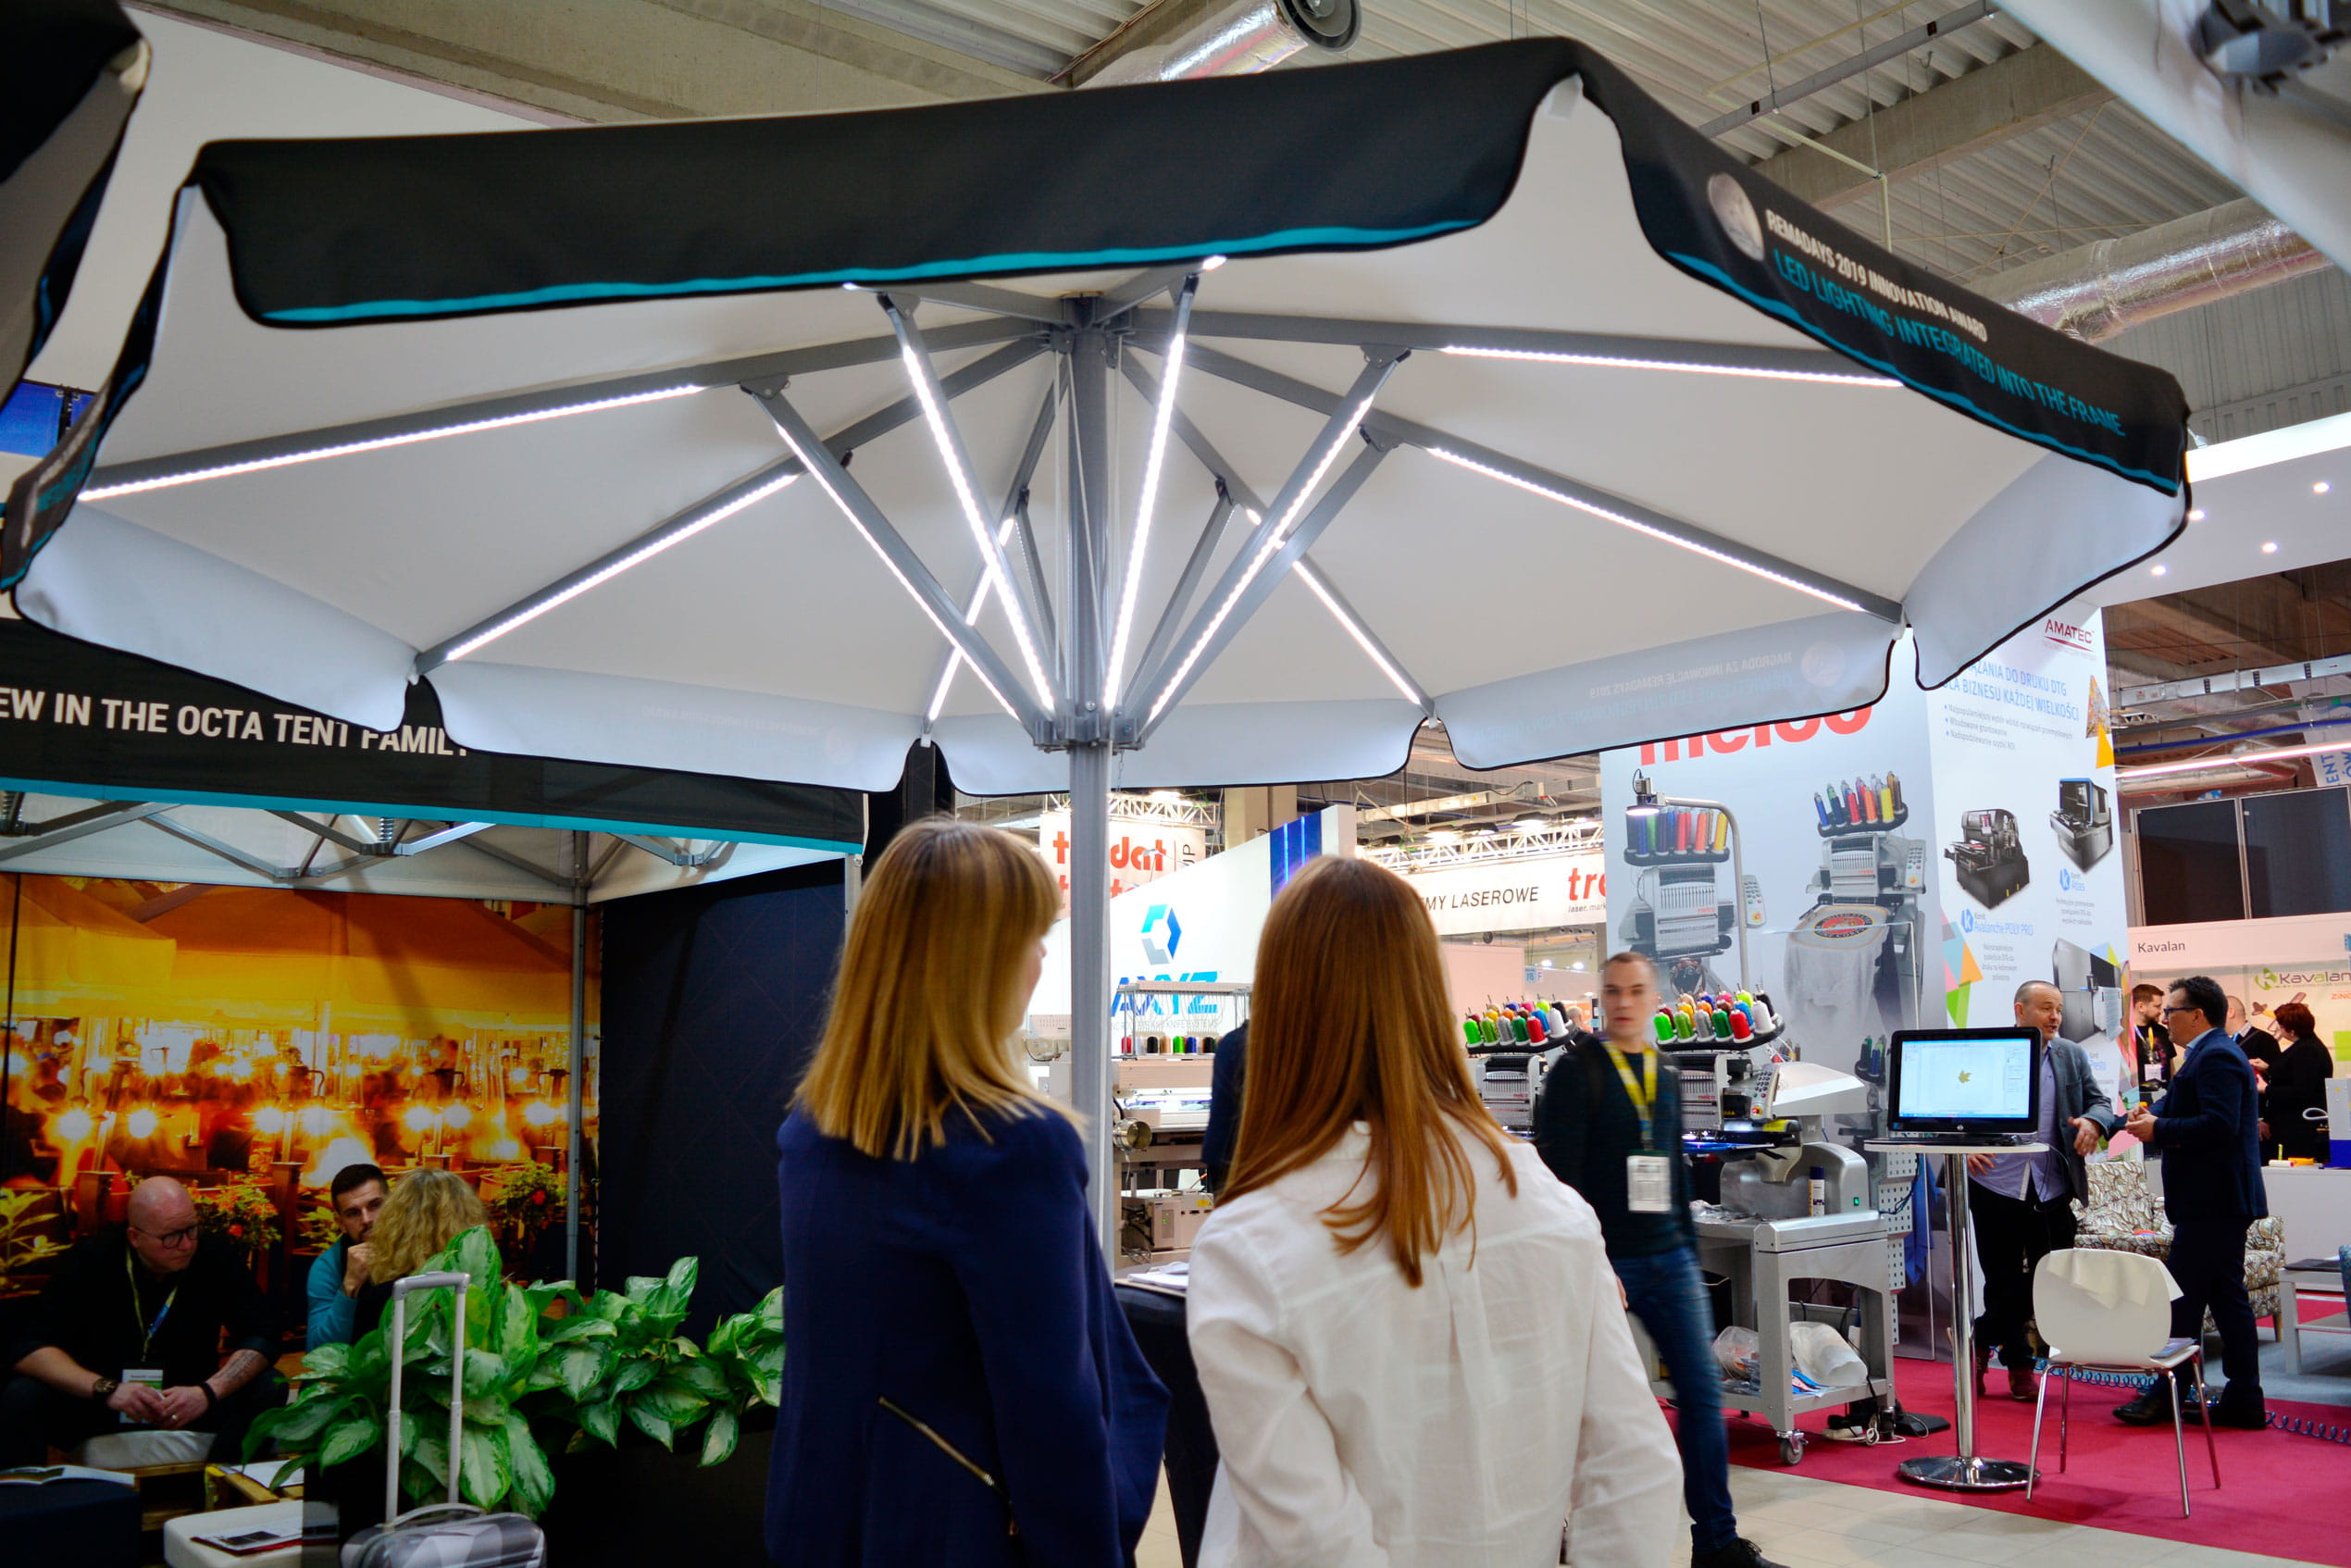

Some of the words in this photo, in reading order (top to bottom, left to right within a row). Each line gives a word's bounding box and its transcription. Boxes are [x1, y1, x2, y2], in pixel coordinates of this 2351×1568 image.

[1765, 209, 1835, 268] REMADAYS
[1835, 253, 1867, 286] 2019
[1868, 269, 1949, 319] INNOVATION
[1948, 305, 1987, 342] AWARD
[1773, 248, 1810, 292] LED
[1810, 270, 1895, 337] LIGHTING
[1896, 316, 1996, 384] INTEGRATED
[1996, 365, 2035, 400] INTO
[2034, 381, 2070, 416] THE
[2067, 395, 2126, 437] FRAME
[2045, 618, 2093, 644] AMATEC
[1962, 678, 2001, 702] BIZNESU
[2004, 689, 2034, 712] KAŻDEJ
[2035, 697, 2080, 721] WIELKOŚCI
[2006, 667, 2019, 683] DO
[2021, 671, 2049, 691] DRUKU
[2051, 679, 2067, 696] DTG
[54, 692, 91, 726] IN
[101, 698, 169, 733] THE
[177, 705, 264, 740] OCTA
[361, 725, 466, 756] FAMIL
[1451, 886, 1539, 909] LASEROWE
[2137, 941, 2185, 953] Kavalan
